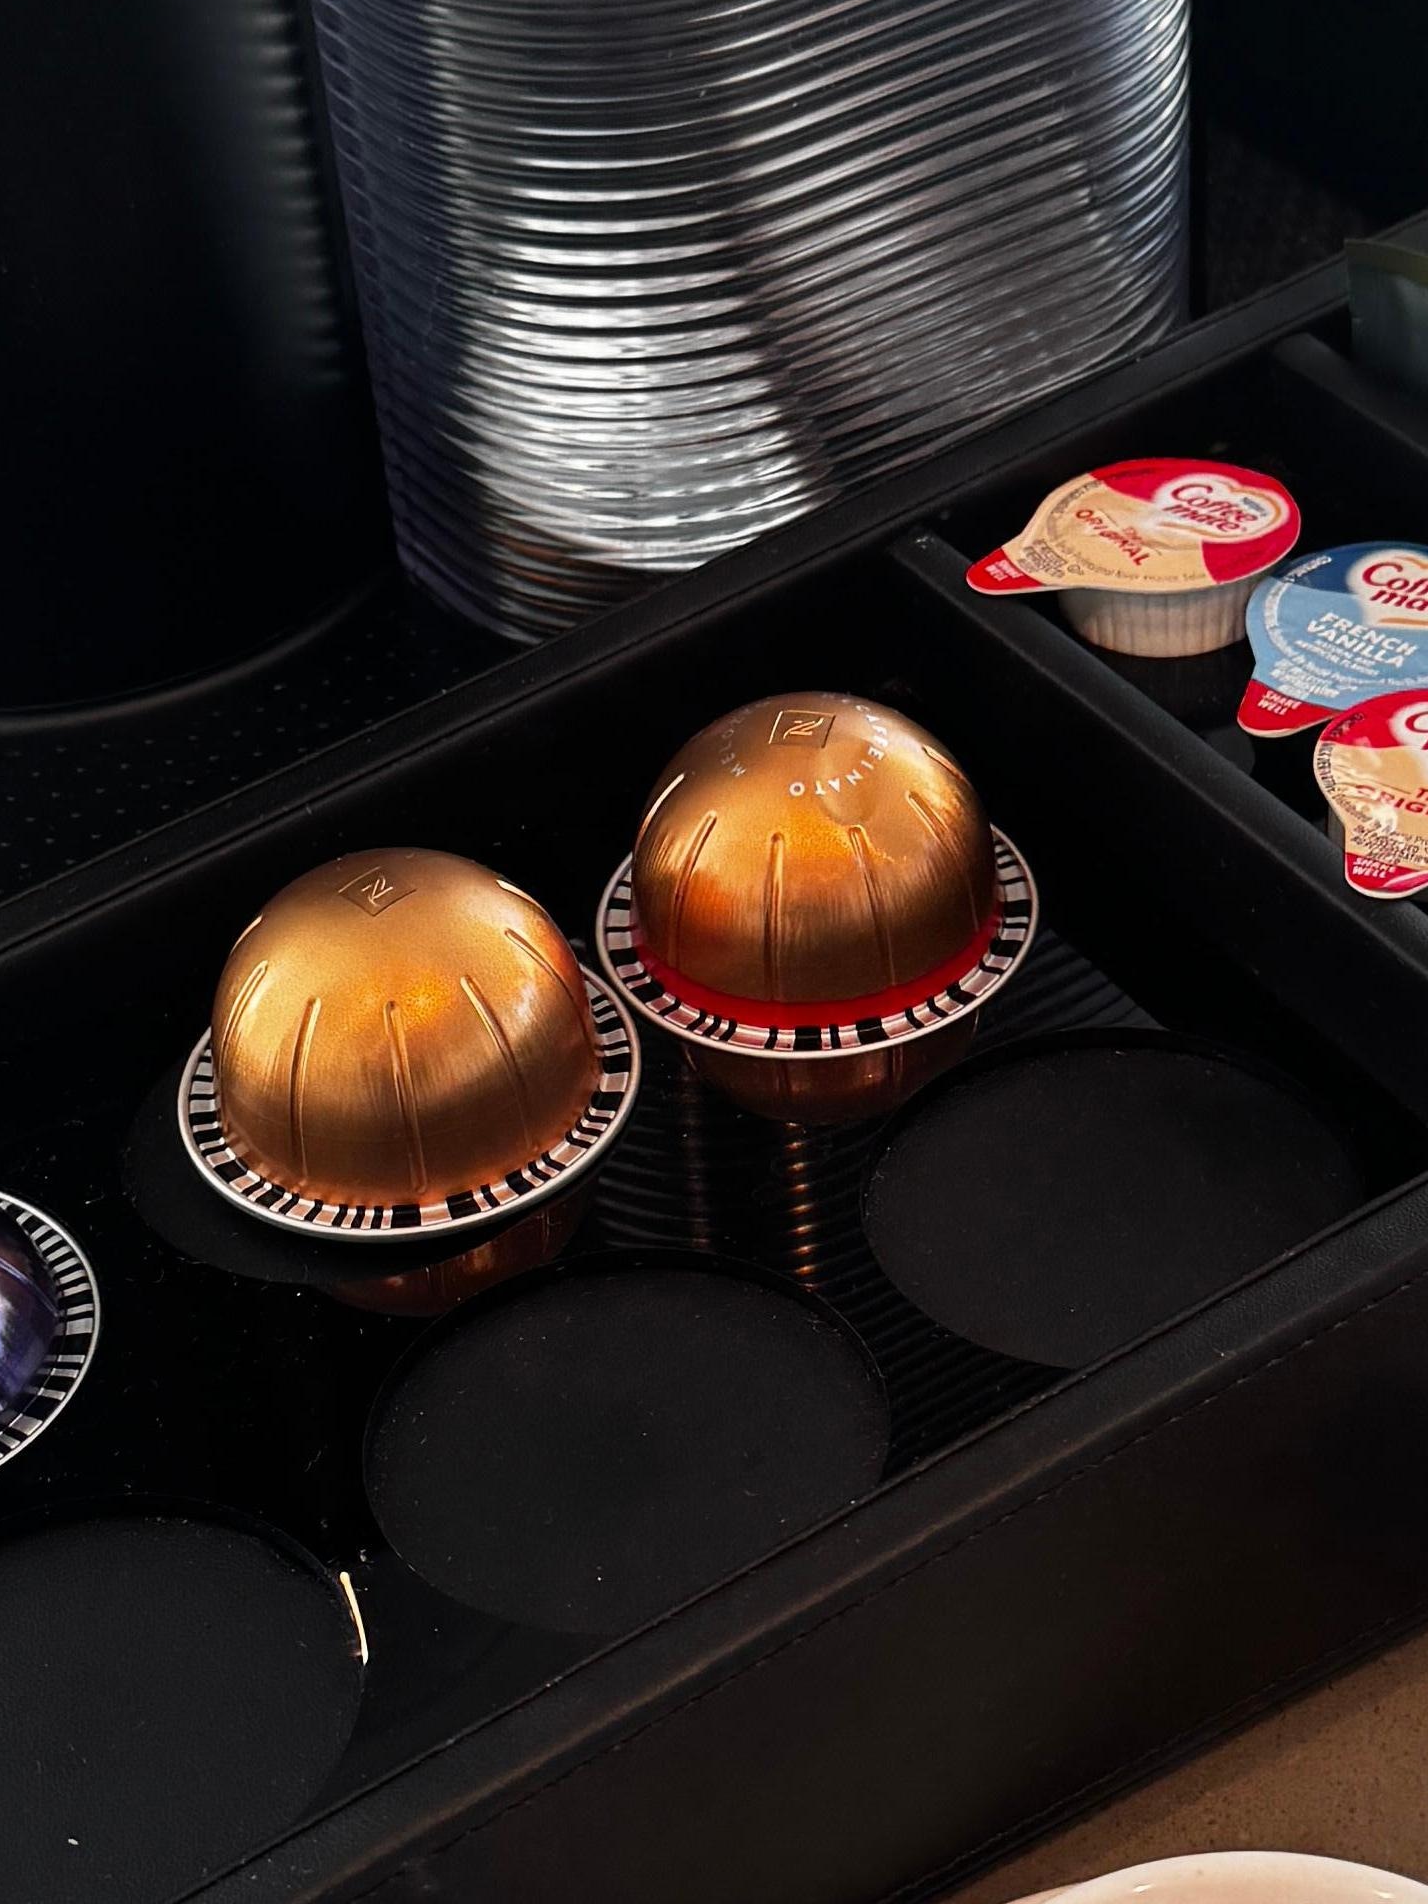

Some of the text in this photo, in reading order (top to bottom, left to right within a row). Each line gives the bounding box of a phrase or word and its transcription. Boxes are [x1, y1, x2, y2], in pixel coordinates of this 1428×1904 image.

[1162, 504, 1240, 532] mate
[1171, 483, 1258, 521] Coffee
[1307, 620, 1404, 669] VANILLA
[1321, 612, 1417, 656] FRENCH
[1257, 699, 1289, 716] WELL
[1352, 867, 1389, 879] WELL
